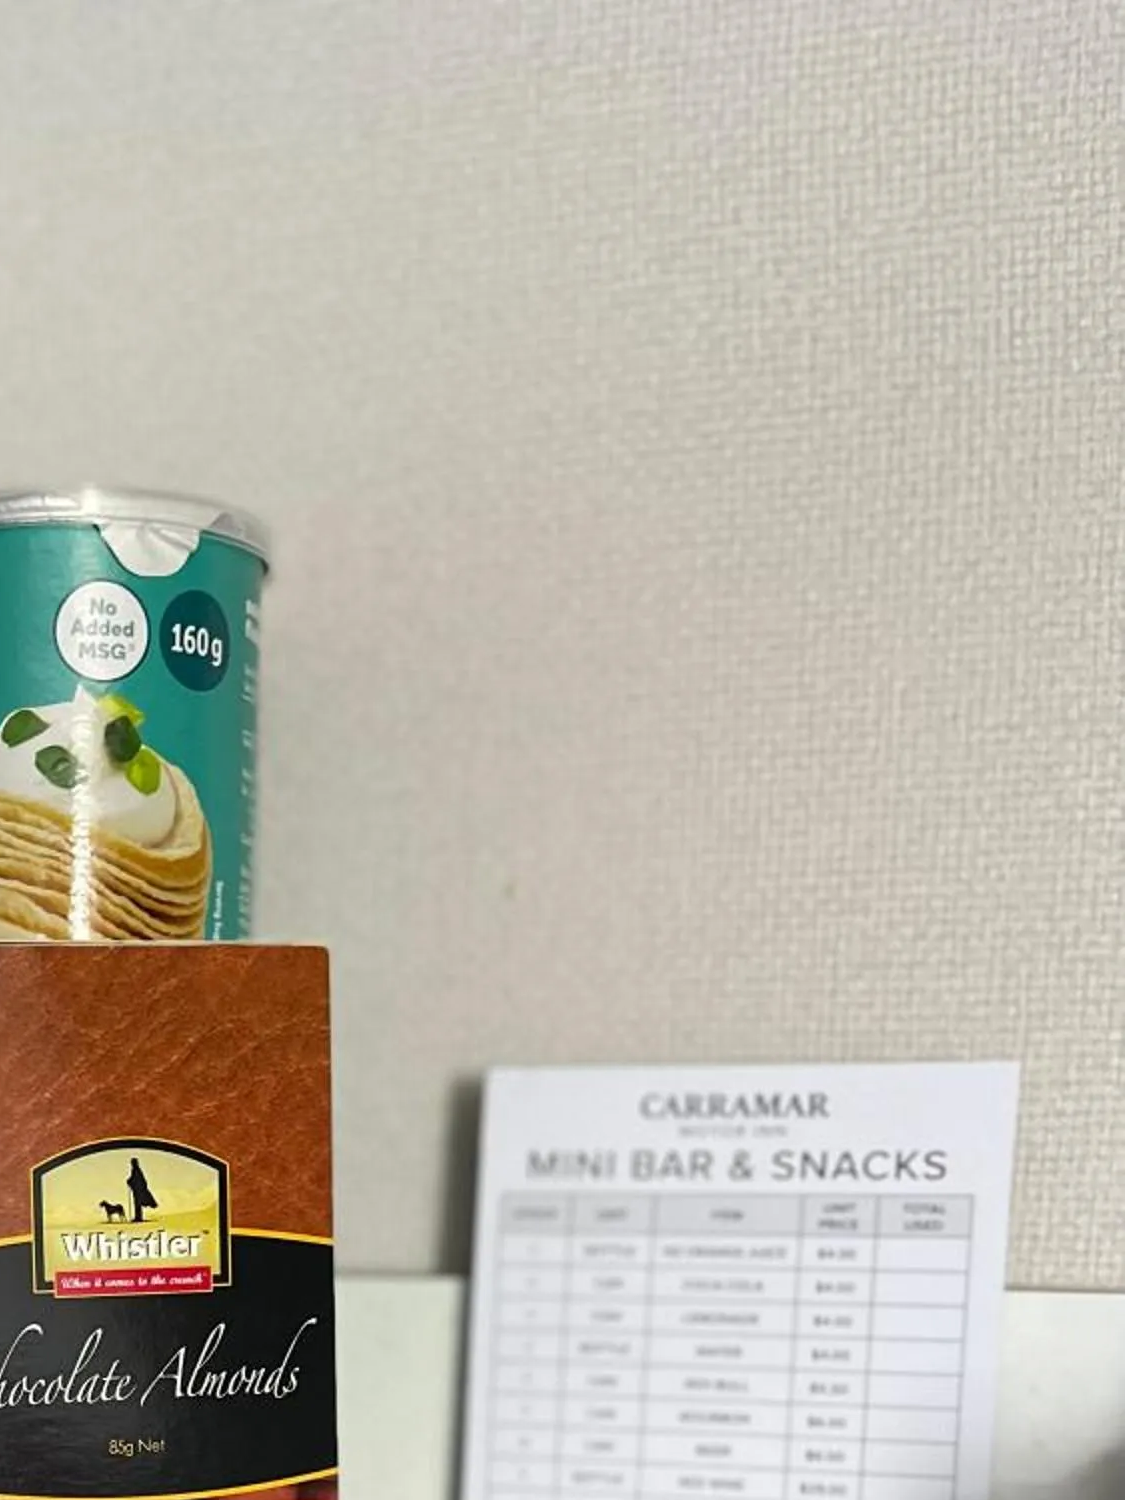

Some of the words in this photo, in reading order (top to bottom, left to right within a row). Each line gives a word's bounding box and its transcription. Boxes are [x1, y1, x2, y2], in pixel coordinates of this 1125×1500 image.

[89, 599, 117, 616] No
[70, 620, 135, 638] Added
[171, 624, 223, 666] 160g
[638, 1091, 832, 1120] CARRAMAR
[525, 1150, 618, 1180] MINI
[631, 1149, 715, 1180] BAR
[728, 1149, 755, 1181] &
[771, 1149, 948, 1181] SNACKS
[60, 1229, 203, 1262] Whistler
[141, 1317, 317, 1407] Almonds
[108, 1439, 134, 1457] 85g
[138, 1438, 165, 1453] Net
